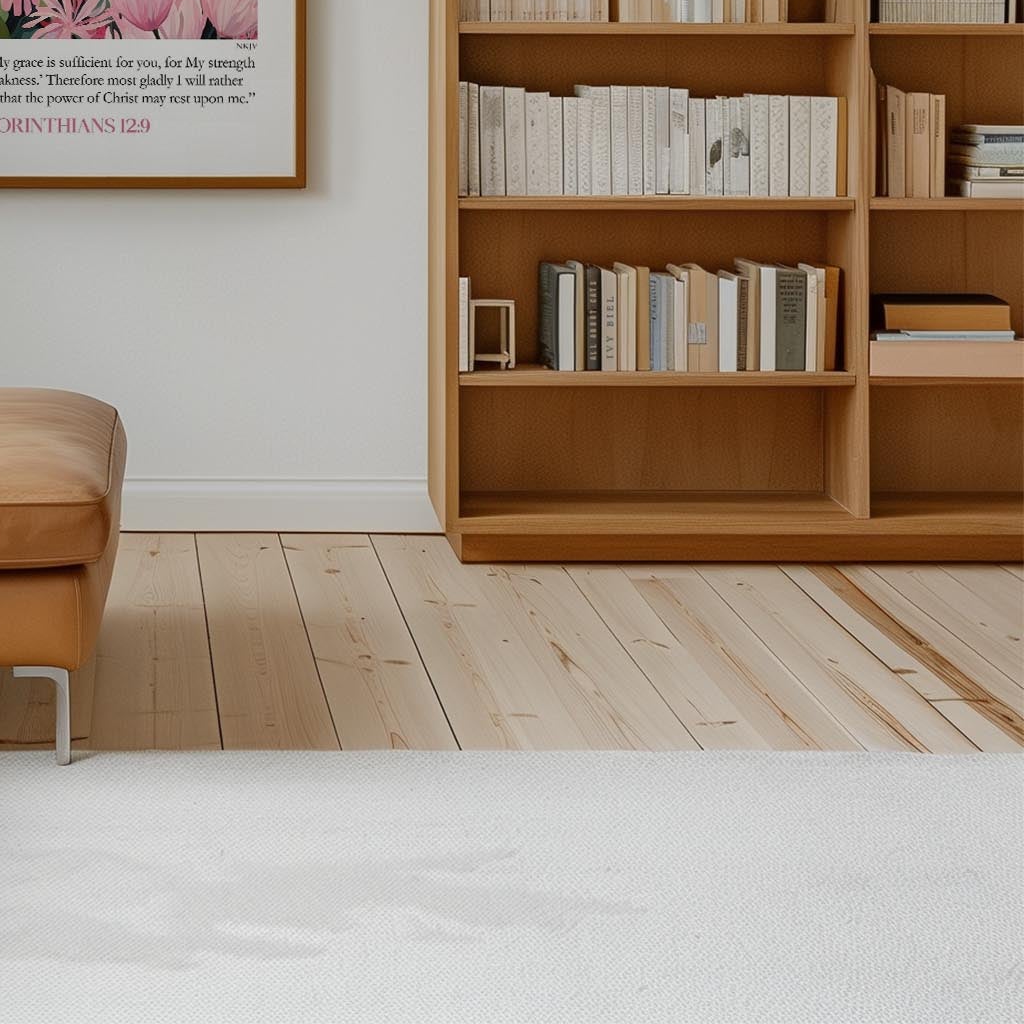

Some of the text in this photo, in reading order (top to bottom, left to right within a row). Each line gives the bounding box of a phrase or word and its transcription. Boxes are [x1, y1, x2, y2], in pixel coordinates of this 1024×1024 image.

[236, 43, 257, 51] NKJV
[13, 57, 44, 71] grace
[46, 56, 56, 67] is
[59, 56, 112, 71] sufficient
[115, 56, 134, 69] for
[137, 60, 161, 72] you,
[164, 56, 182, 68] for
[185, 57, 205, 71] My
[208, 56, 255, 72] strength
[47, 74, 105, 86] Therefore
[107, 76, 137, 86] most
[139, 74, 174, 90] gladly
[176, 74, 182, 86] I
[185, 74, 206, 86] will
[209, 74, 243, 86] rather
[0, 91, 22, 103] that
[25, 92, 44, 103] the
[47, 96, 84, 107] power
[87, 92, 101, 103] of
[103, 91, 139, 104] Christ
[142, 96, 166, 107] may
[169, 96, 190, 104] rest
[193, 96, 224, 108] upon
[120, 118, 150, 133] 12:9
[606, 335, 614, 359] IVY
